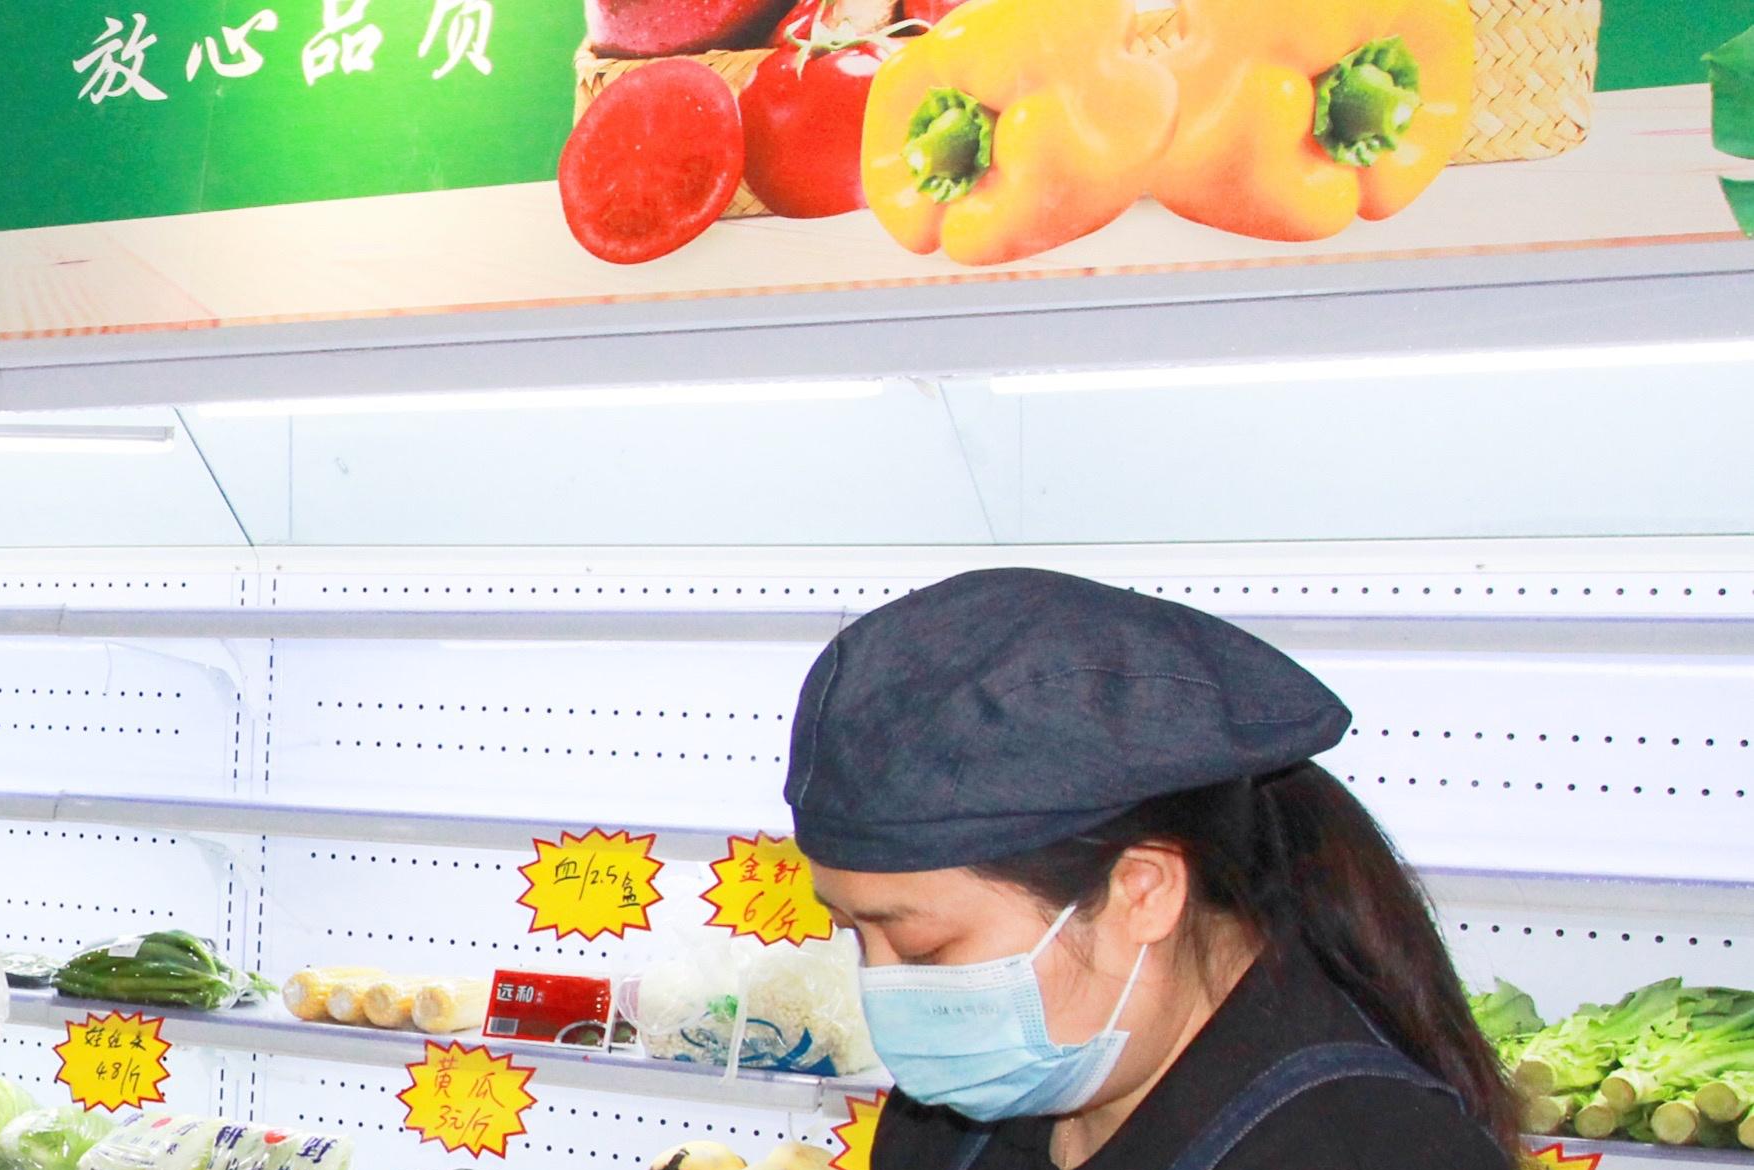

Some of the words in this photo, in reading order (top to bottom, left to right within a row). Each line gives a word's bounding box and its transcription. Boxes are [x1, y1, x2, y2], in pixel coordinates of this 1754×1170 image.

[72, 0, 494, 104] 放心品质
[434, 1054, 505, 1108] 黄瓜
